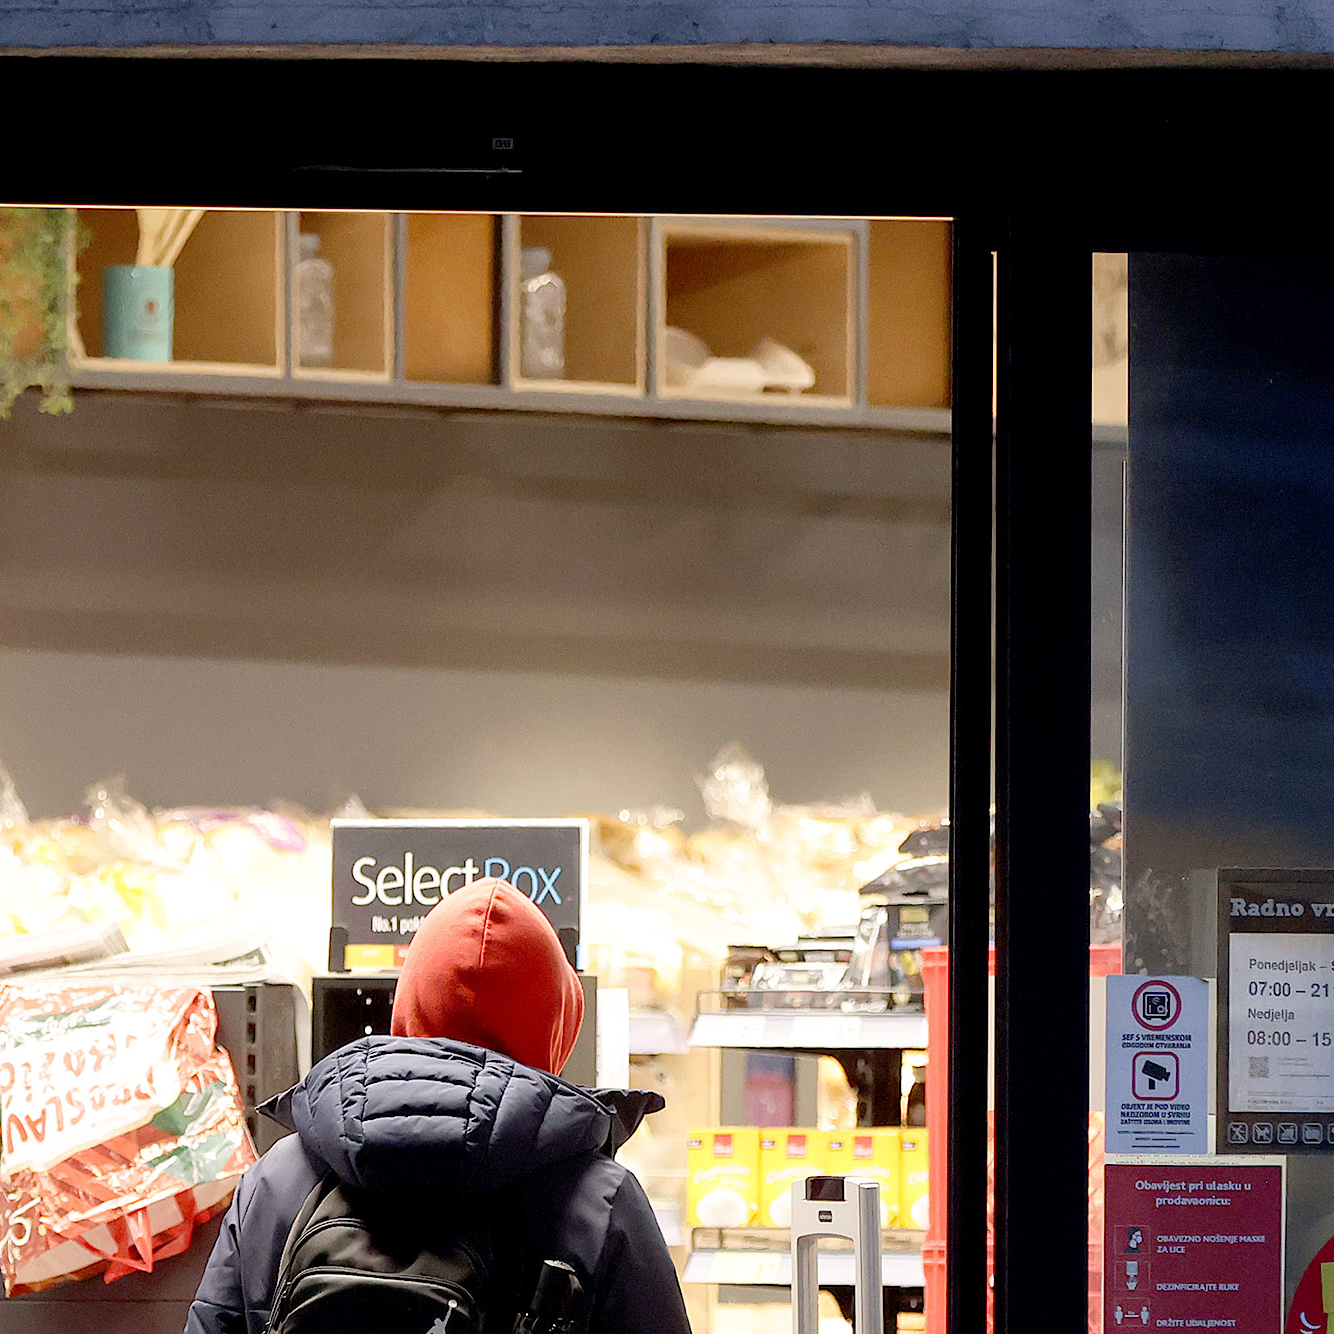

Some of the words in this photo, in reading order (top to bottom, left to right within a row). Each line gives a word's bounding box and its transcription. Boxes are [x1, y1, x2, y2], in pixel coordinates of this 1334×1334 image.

[1230, 898, 1304, 917] Radno
[1249, 958, 1316, 973] Ponedjeljak
[1248, 982, 1291, 997] 07:00
[1248, 1008, 1295, 1022] Nedjelja
[1247, 1031, 1291, 1047] 08:00
[1135, 1180, 1186, 1193] Obavijest
[1188, 1181, 1203, 1194] pri
[1206, 1181, 1242, 1192] ulasku
[1244, 1183, 1251, 1191] u
[1155, 1195, 1231, 1207] prodavaonicu:
[1156, 1235, 1201, 1243] OBAVEZNO
[1203, 1233, 1238, 1244] NOŠENJE
